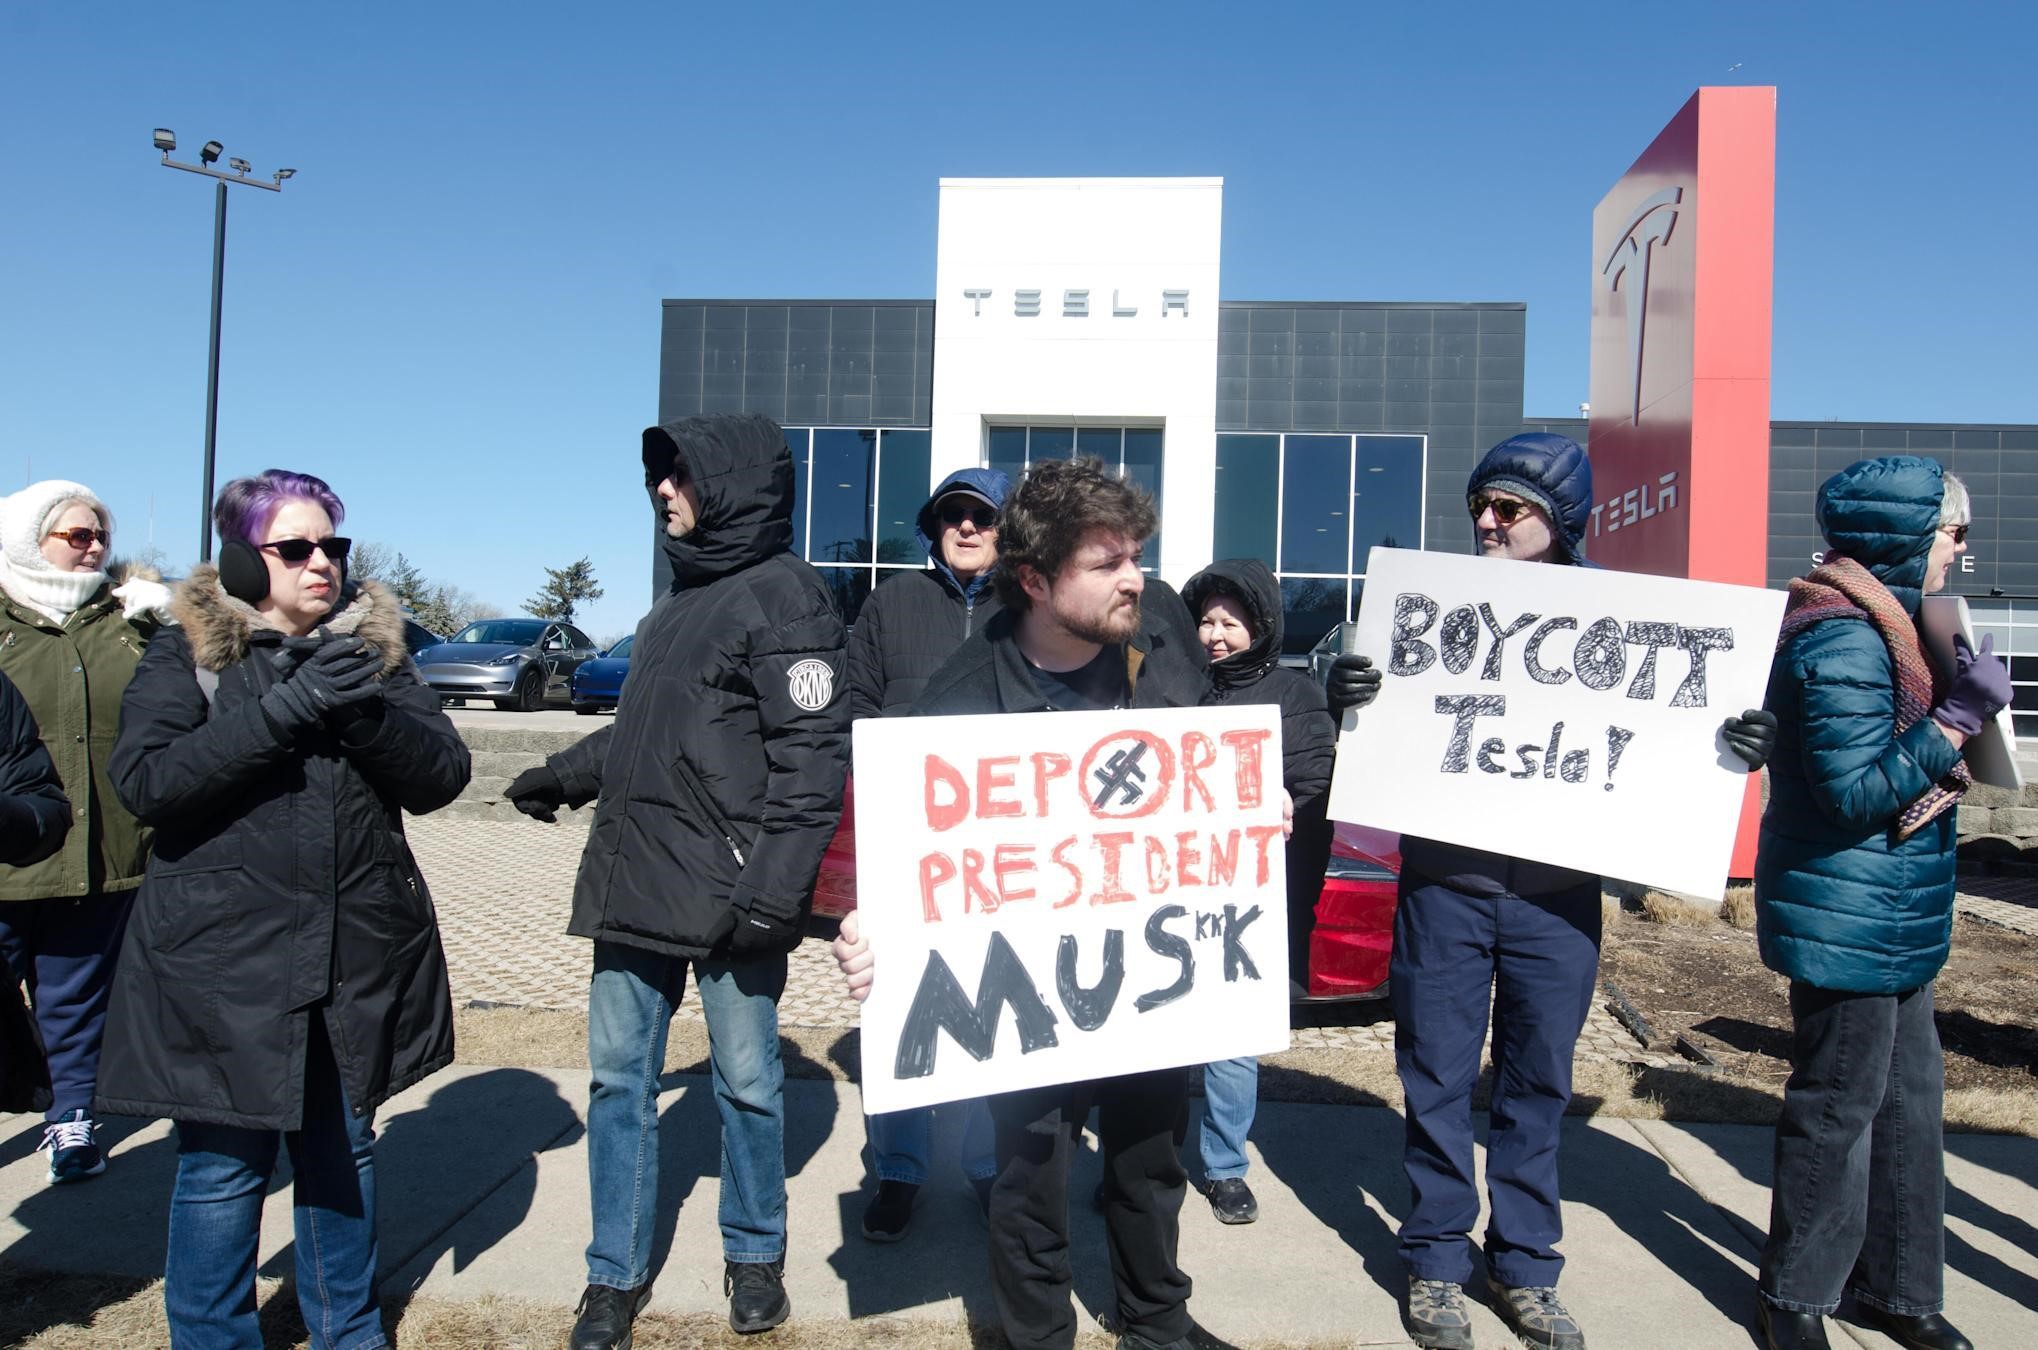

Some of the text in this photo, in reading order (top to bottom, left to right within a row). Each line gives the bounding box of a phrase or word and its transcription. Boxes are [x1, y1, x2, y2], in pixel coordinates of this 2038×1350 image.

[963, 288, 1190, 317] TESLA
[1590, 471, 1679, 537] TESLA
[1388, 592, 1734, 708] BOYCOTT
[924, 728, 1272, 832] DEPORT
[1434, 694, 1636, 792] Tesla!
[919, 825, 1283, 923] PRESIDENT
